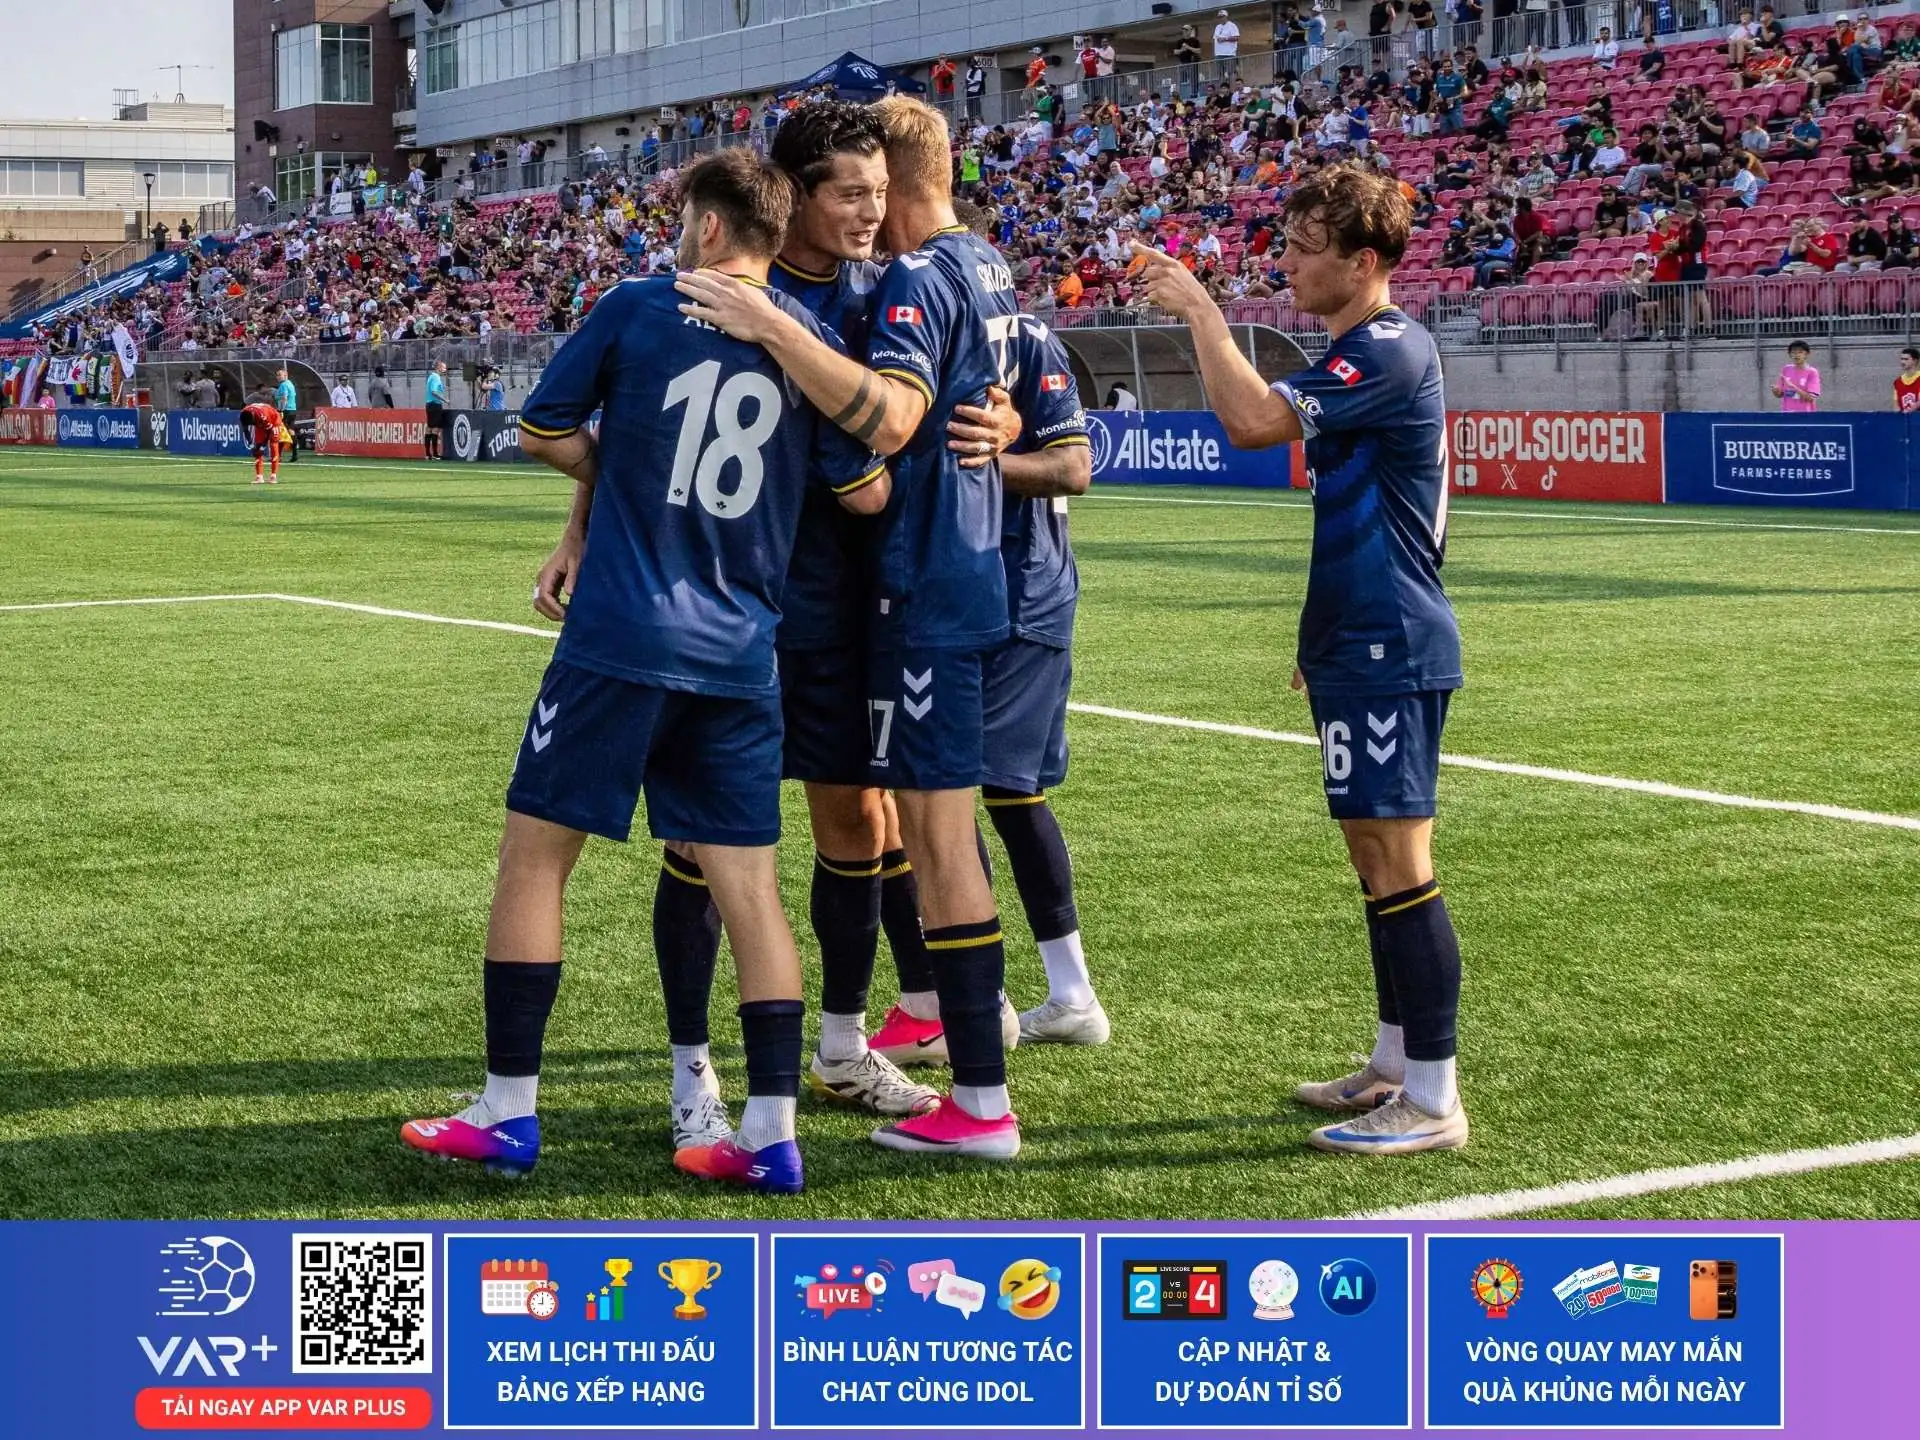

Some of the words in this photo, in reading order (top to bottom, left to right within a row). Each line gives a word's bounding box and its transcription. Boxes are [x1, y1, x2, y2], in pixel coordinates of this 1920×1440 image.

[70, 420, 93, 437] Allstate
[110, 420, 136, 439] Allstate
[505, 414, 520, 424] INTE
[1036, 418, 1079, 438] Moneris
[180, 417, 240, 447] Volkswagen
[329, 421, 365, 443] CANADIAN
[366, 422, 404, 445] PREMIER
[406, 422, 428, 445] LEA
[488, 428, 519, 457] TORO
[662, 359, 782, 519] 18
[1454, 417, 1646, 464] @CPLSOCCER
[1113, 429, 1220, 471] Allstate
[1724, 440, 1837, 460] BURNBRAE
